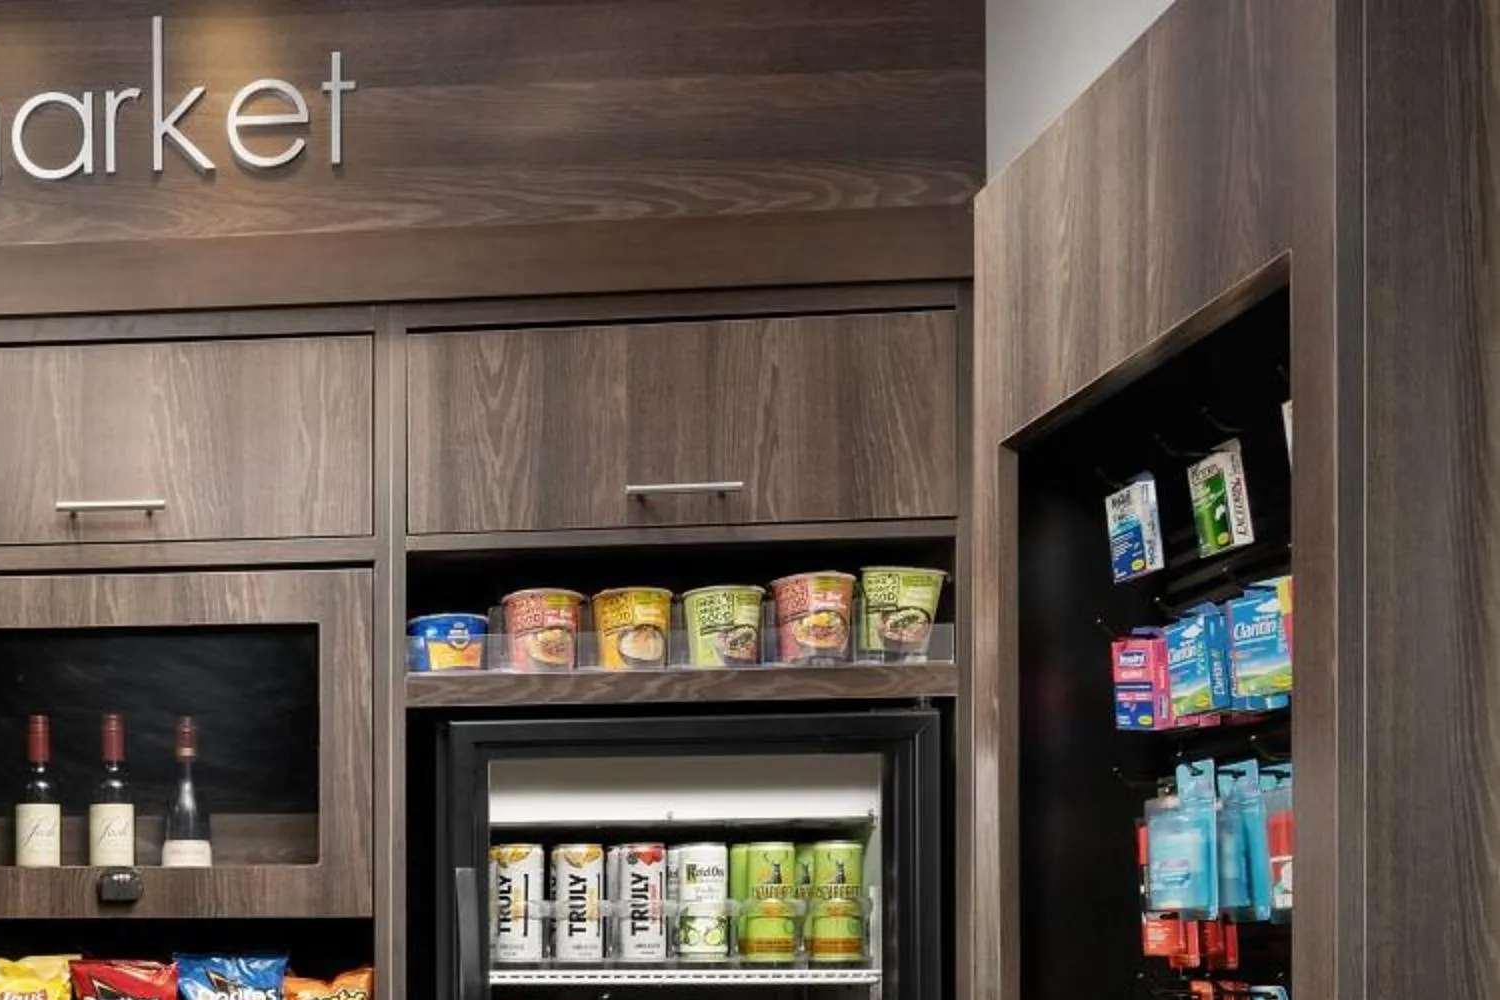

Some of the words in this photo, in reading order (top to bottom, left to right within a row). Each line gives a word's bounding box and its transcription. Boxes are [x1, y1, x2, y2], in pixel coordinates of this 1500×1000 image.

[498, 875, 512, 936] TRULY
[568, 874, 587, 937] TRULY
[631, 873, 649, 936] TRULY
